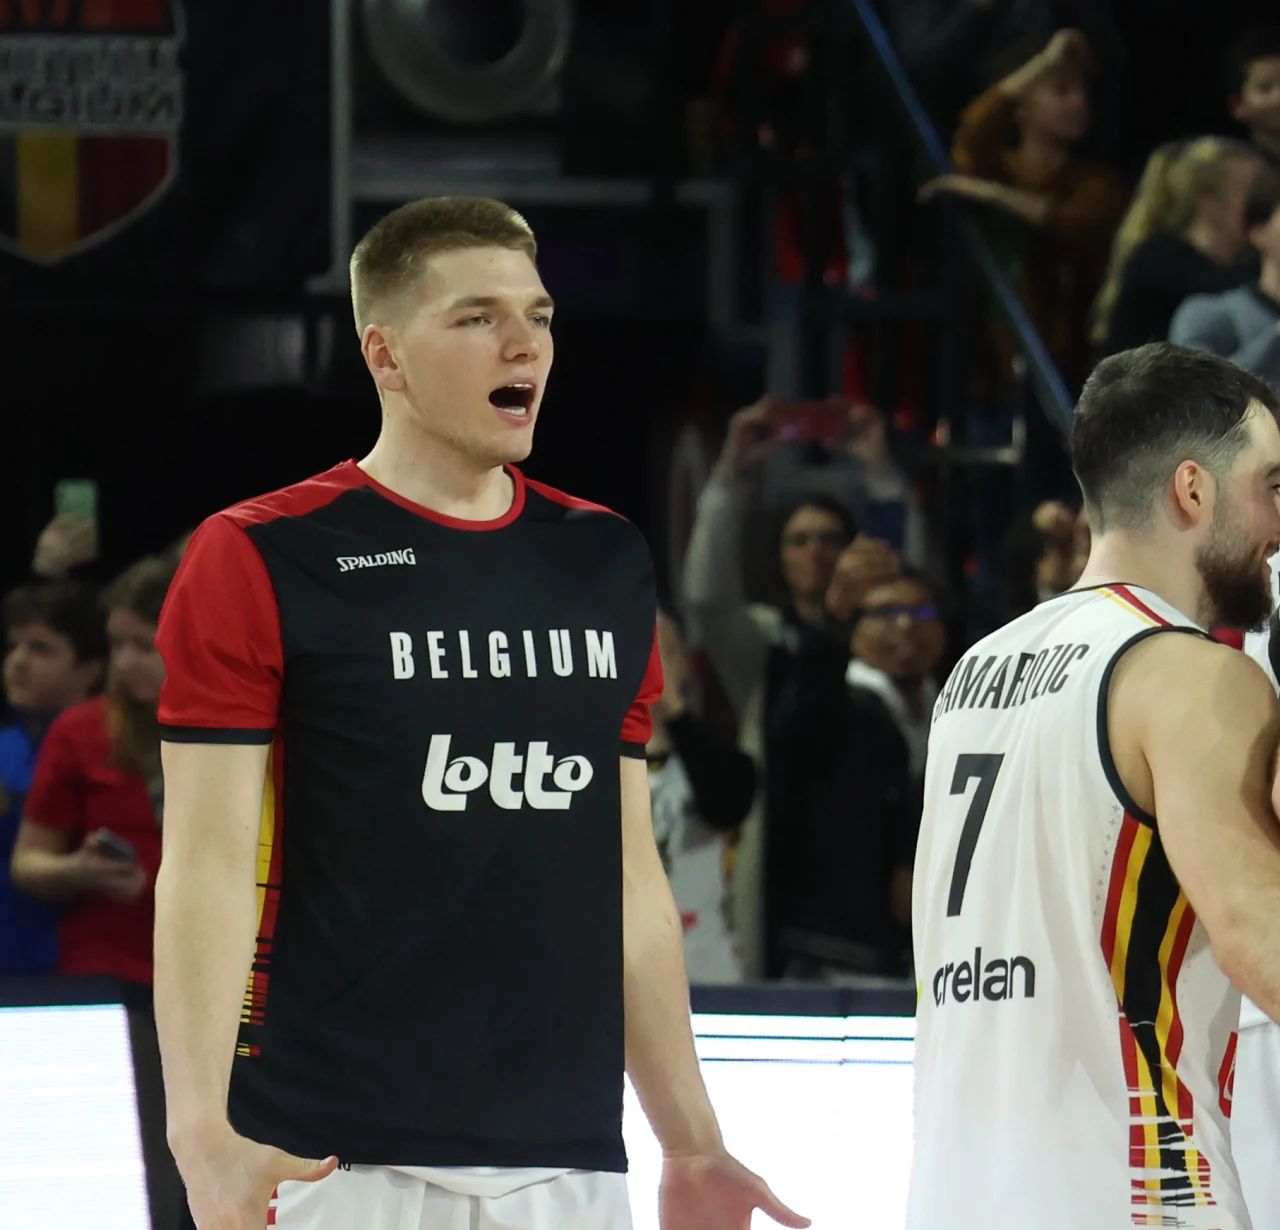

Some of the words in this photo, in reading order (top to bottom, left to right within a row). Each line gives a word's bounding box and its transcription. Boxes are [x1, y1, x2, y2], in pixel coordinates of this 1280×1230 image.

[336, 547, 416, 572] SPALDING
[388, 628, 618, 680] BELGIUM
[946, 752, 1006, 917] 7
[932, 946, 1036, 1008] crelan
